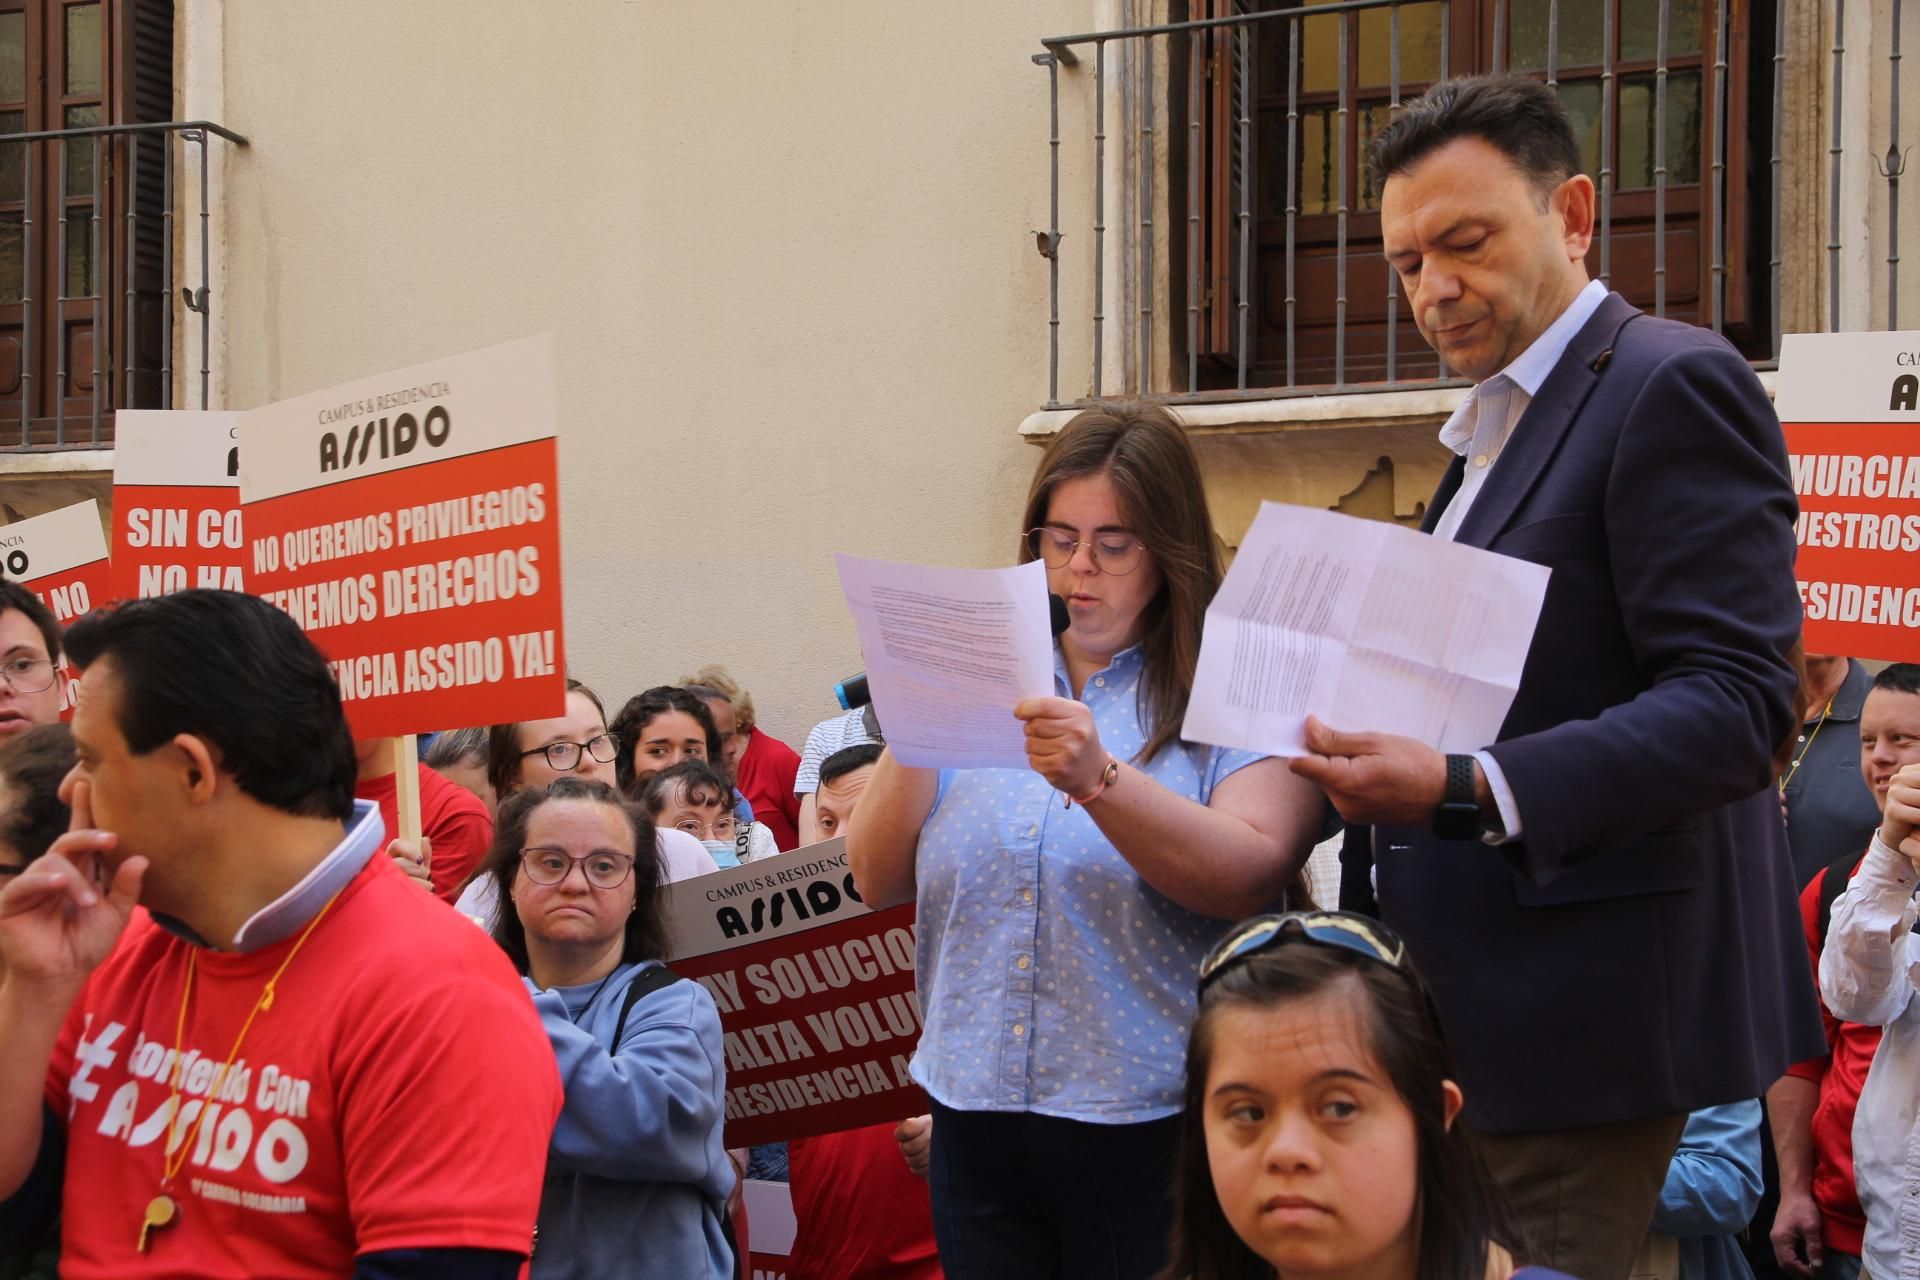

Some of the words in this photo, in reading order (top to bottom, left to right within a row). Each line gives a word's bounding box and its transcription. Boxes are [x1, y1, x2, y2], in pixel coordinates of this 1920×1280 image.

[1897, 352, 1920, 366] CA
[318, 400, 364, 425] CAMPUS
[367, 398, 376, 413] &
[377, 381, 450, 411] RESIDENCIA
[319, 405, 450, 473] ASSIDO
[1788, 454, 1920, 499] MURCIA
[127, 508, 188, 547] SIN
[253, 536, 279, 575] NO
[283, 512, 394, 571] QUEREMOS
[397, 482, 546, 547] PRIVILEGIOS
[0, 550, 29, 577] O
[139, 564, 187, 600] NO
[382, 546, 540, 618] DERECHOS
[51, 581, 91, 622] NO
[403, 637, 503, 694] ASSIDO
[508, 629, 555, 679] YA!
[706, 878, 764, 903] CAMPUS
[765, 875, 777, 888] &
[745, 924, 917, 1005] SOLUCIO
[724, 1020, 815, 1073] ALTA
[256, 1064, 311, 1118] Con
[724, 1060, 894, 1123] RESIDENCIA
[891, 1053, 917, 1088] A
[97, 1080, 309, 1184] ASSIDO
